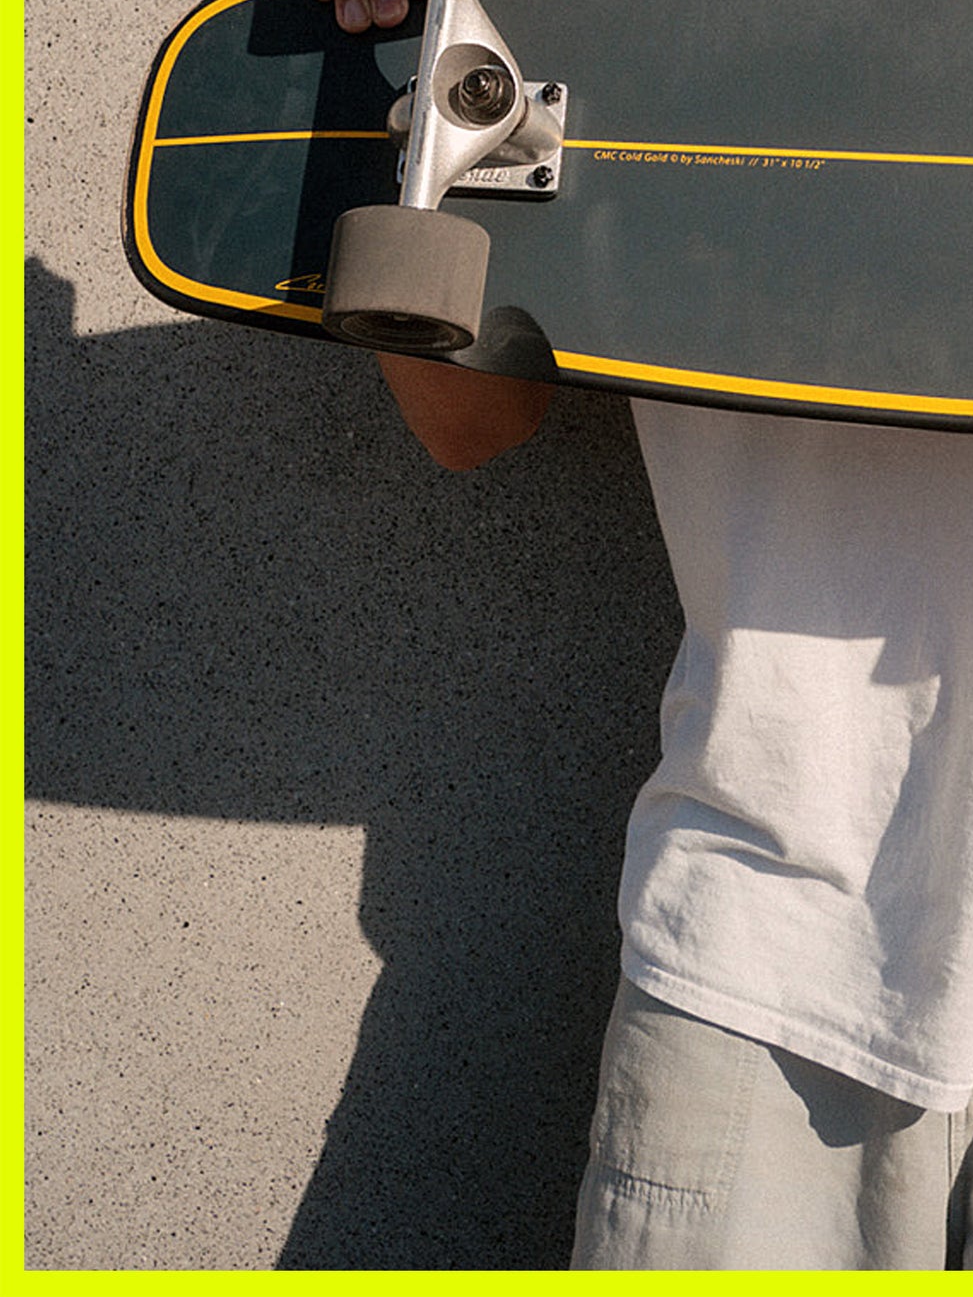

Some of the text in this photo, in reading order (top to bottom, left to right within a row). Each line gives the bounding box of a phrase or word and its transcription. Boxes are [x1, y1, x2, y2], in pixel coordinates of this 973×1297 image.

[593, 150, 618, 161] CMC
[619, 151, 643, 162] Cold
[644, 152, 668, 163] Gold
[680, 154, 693, 166] by
[790, 158, 803, 169] 10
